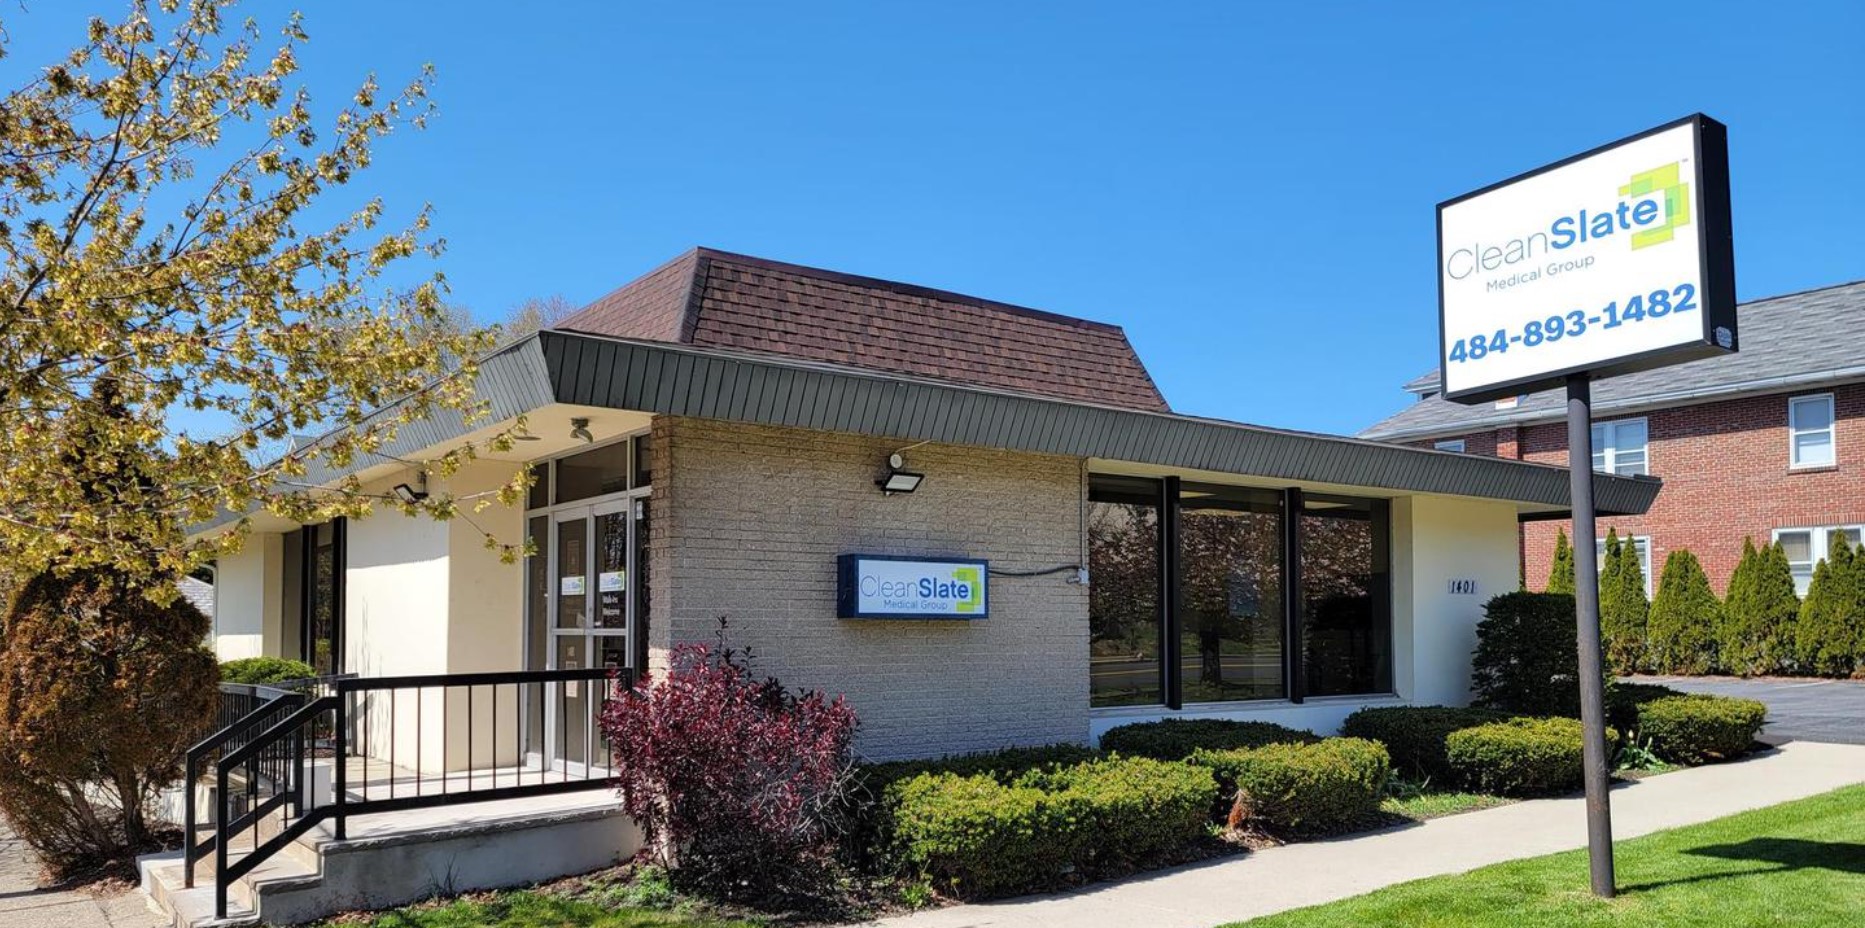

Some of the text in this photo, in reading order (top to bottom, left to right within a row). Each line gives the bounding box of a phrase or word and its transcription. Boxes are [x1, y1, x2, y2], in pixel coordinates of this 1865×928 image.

[1447, 199, 1658, 280] CleanSlate
[1486, 255, 1595, 292] Medical Group
[1449, 283, 1697, 363] 484-893-1482
[860, 575, 969, 599] CleanSlate
[1451, 580, 1475, 594] 1401
[884, 600, 947, 610] Medical Group
